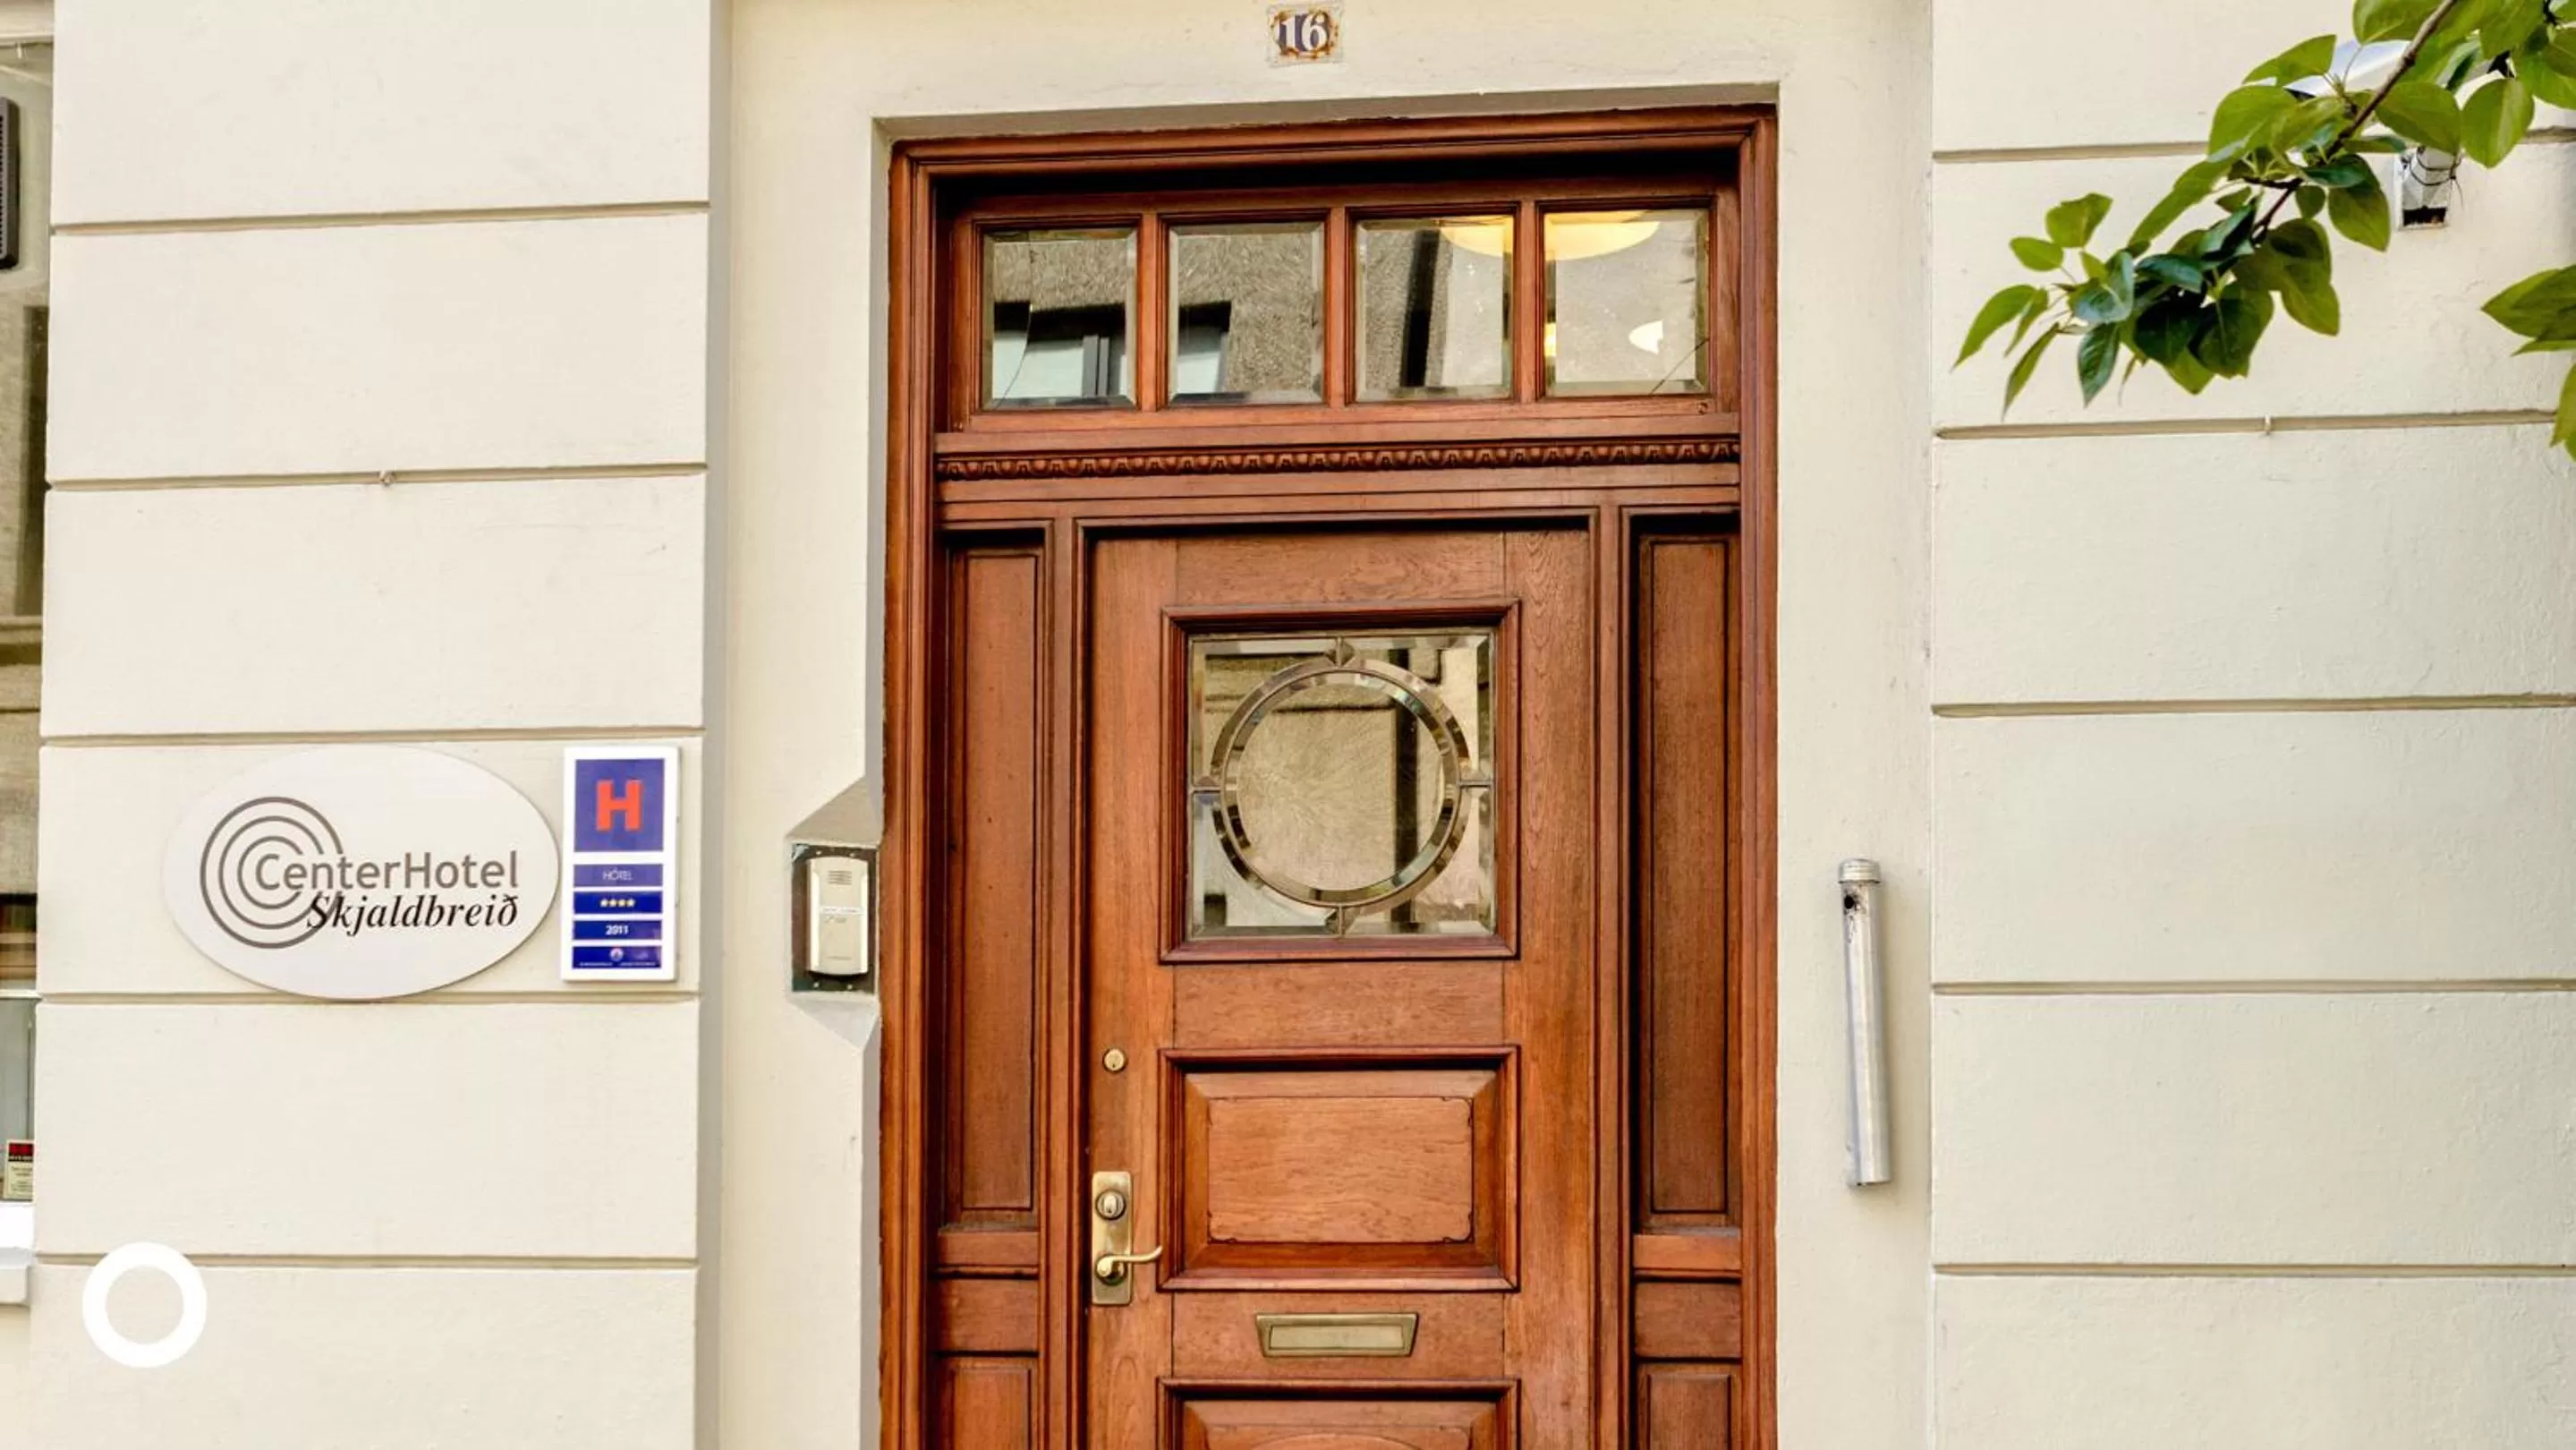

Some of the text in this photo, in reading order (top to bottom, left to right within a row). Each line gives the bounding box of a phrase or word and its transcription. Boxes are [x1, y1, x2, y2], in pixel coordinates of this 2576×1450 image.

[1280, 13, 1329, 52] 16
[596, 780, 642, 832] H
[255, 850, 519, 891] CenterHotel
[307, 893, 519, 936] Skjaldbreið
[605, 925, 629, 935] 2011
